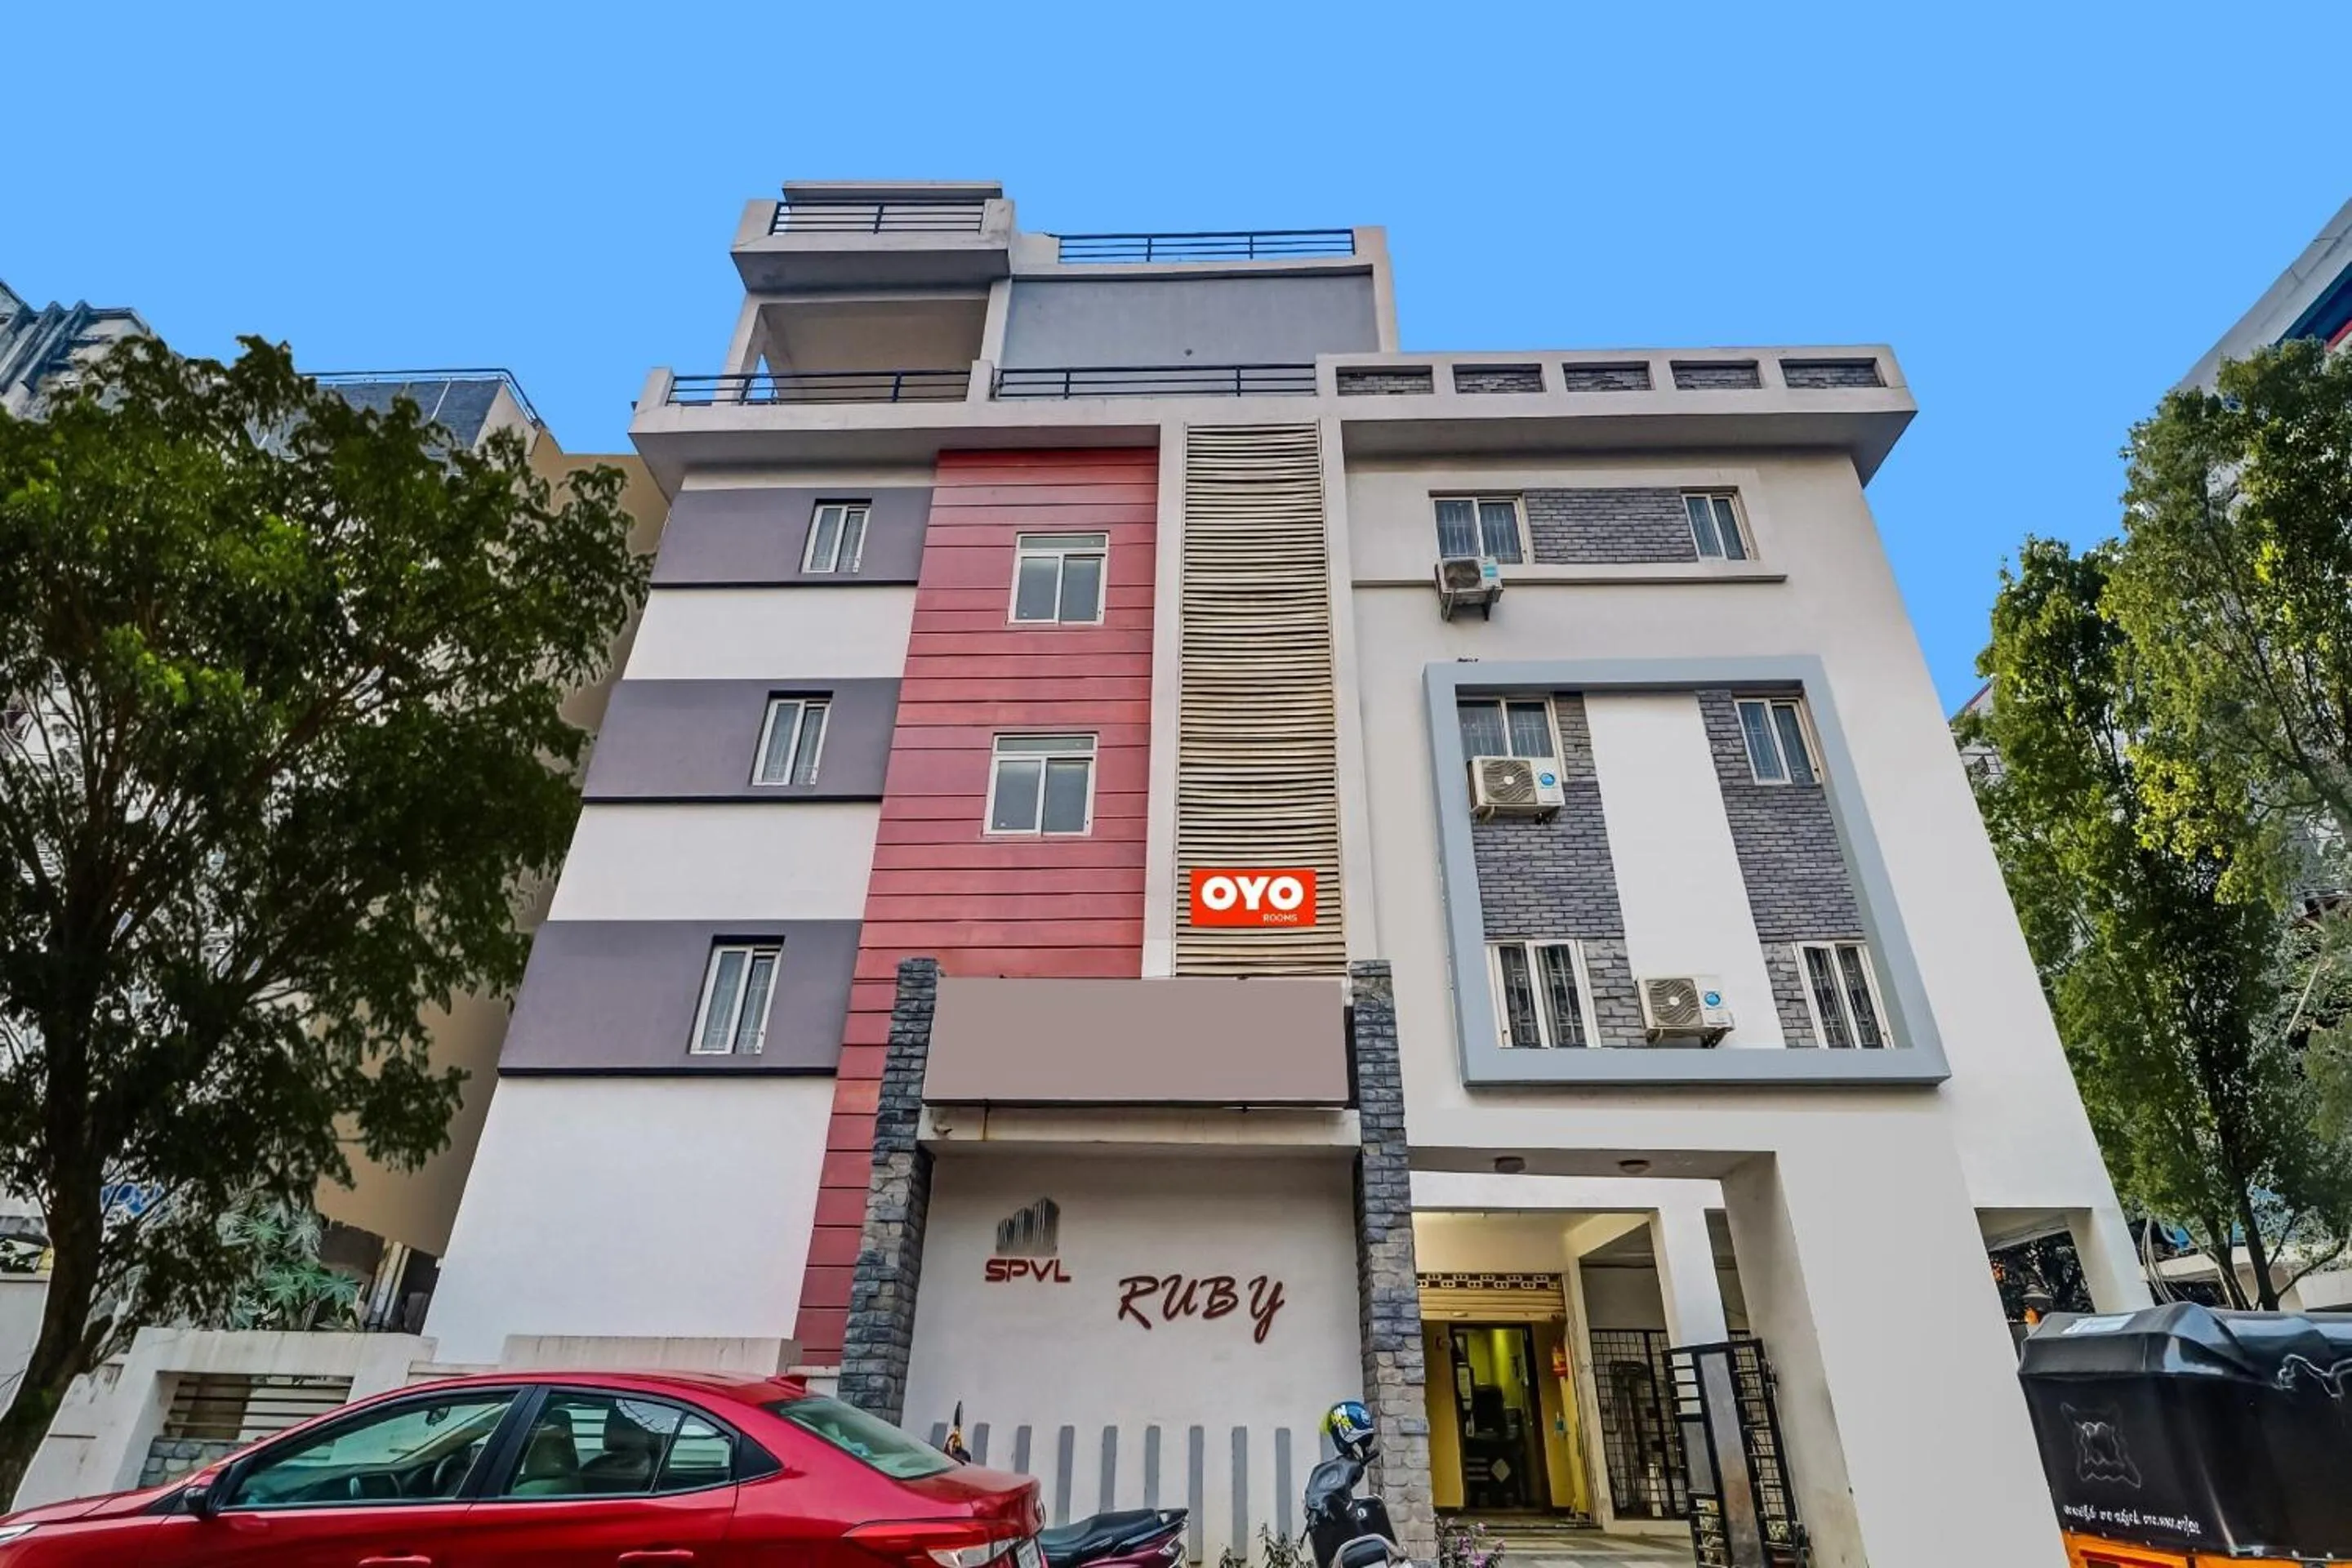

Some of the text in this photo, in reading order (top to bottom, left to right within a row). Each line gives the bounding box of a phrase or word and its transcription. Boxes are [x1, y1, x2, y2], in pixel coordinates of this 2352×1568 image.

[1201, 875, 1304, 911] OYO
[1263, 914, 1298, 923] ROOMS
[985, 1258, 1071, 1283] SPVL
[1118, 1274, 1285, 1344] RUBY
